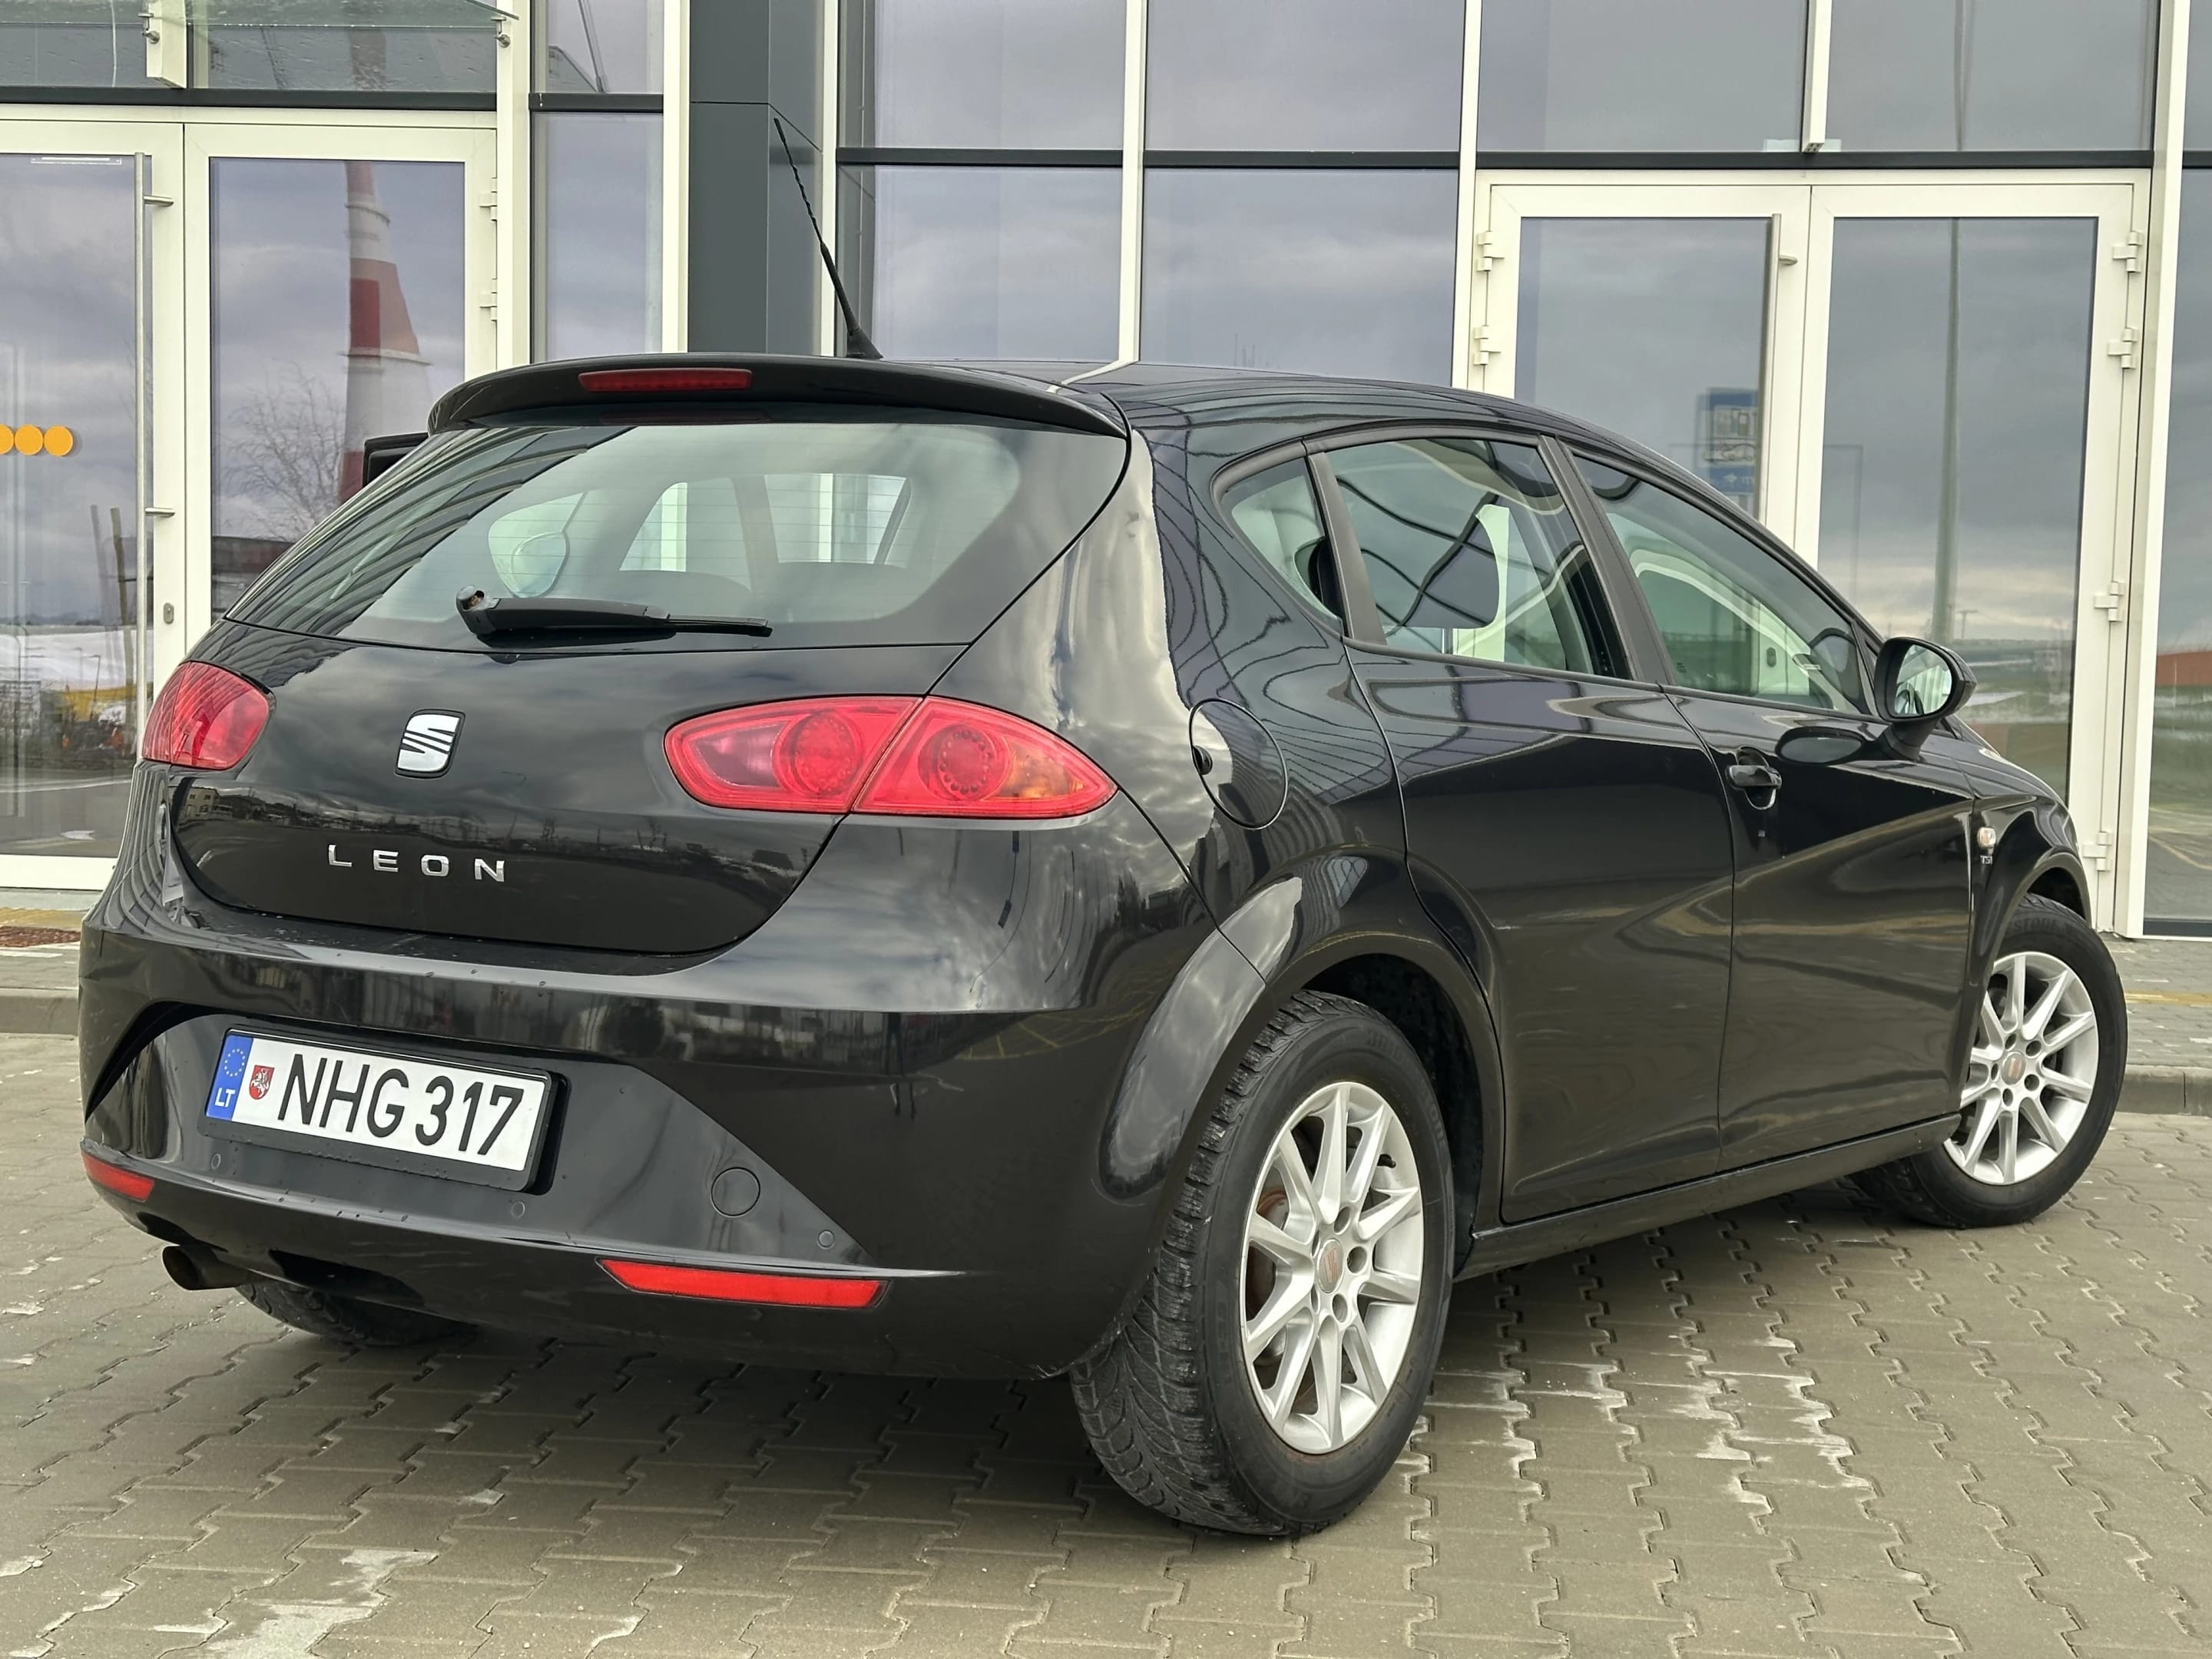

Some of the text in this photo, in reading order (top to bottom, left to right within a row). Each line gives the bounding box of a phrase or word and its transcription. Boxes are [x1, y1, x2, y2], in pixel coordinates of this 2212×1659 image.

[327, 843, 505, 882] LEON
[1980, 854, 1993, 865] TSI
[214, 1087, 236, 1108] LT
[276, 1053, 525, 1157] NHG 317
